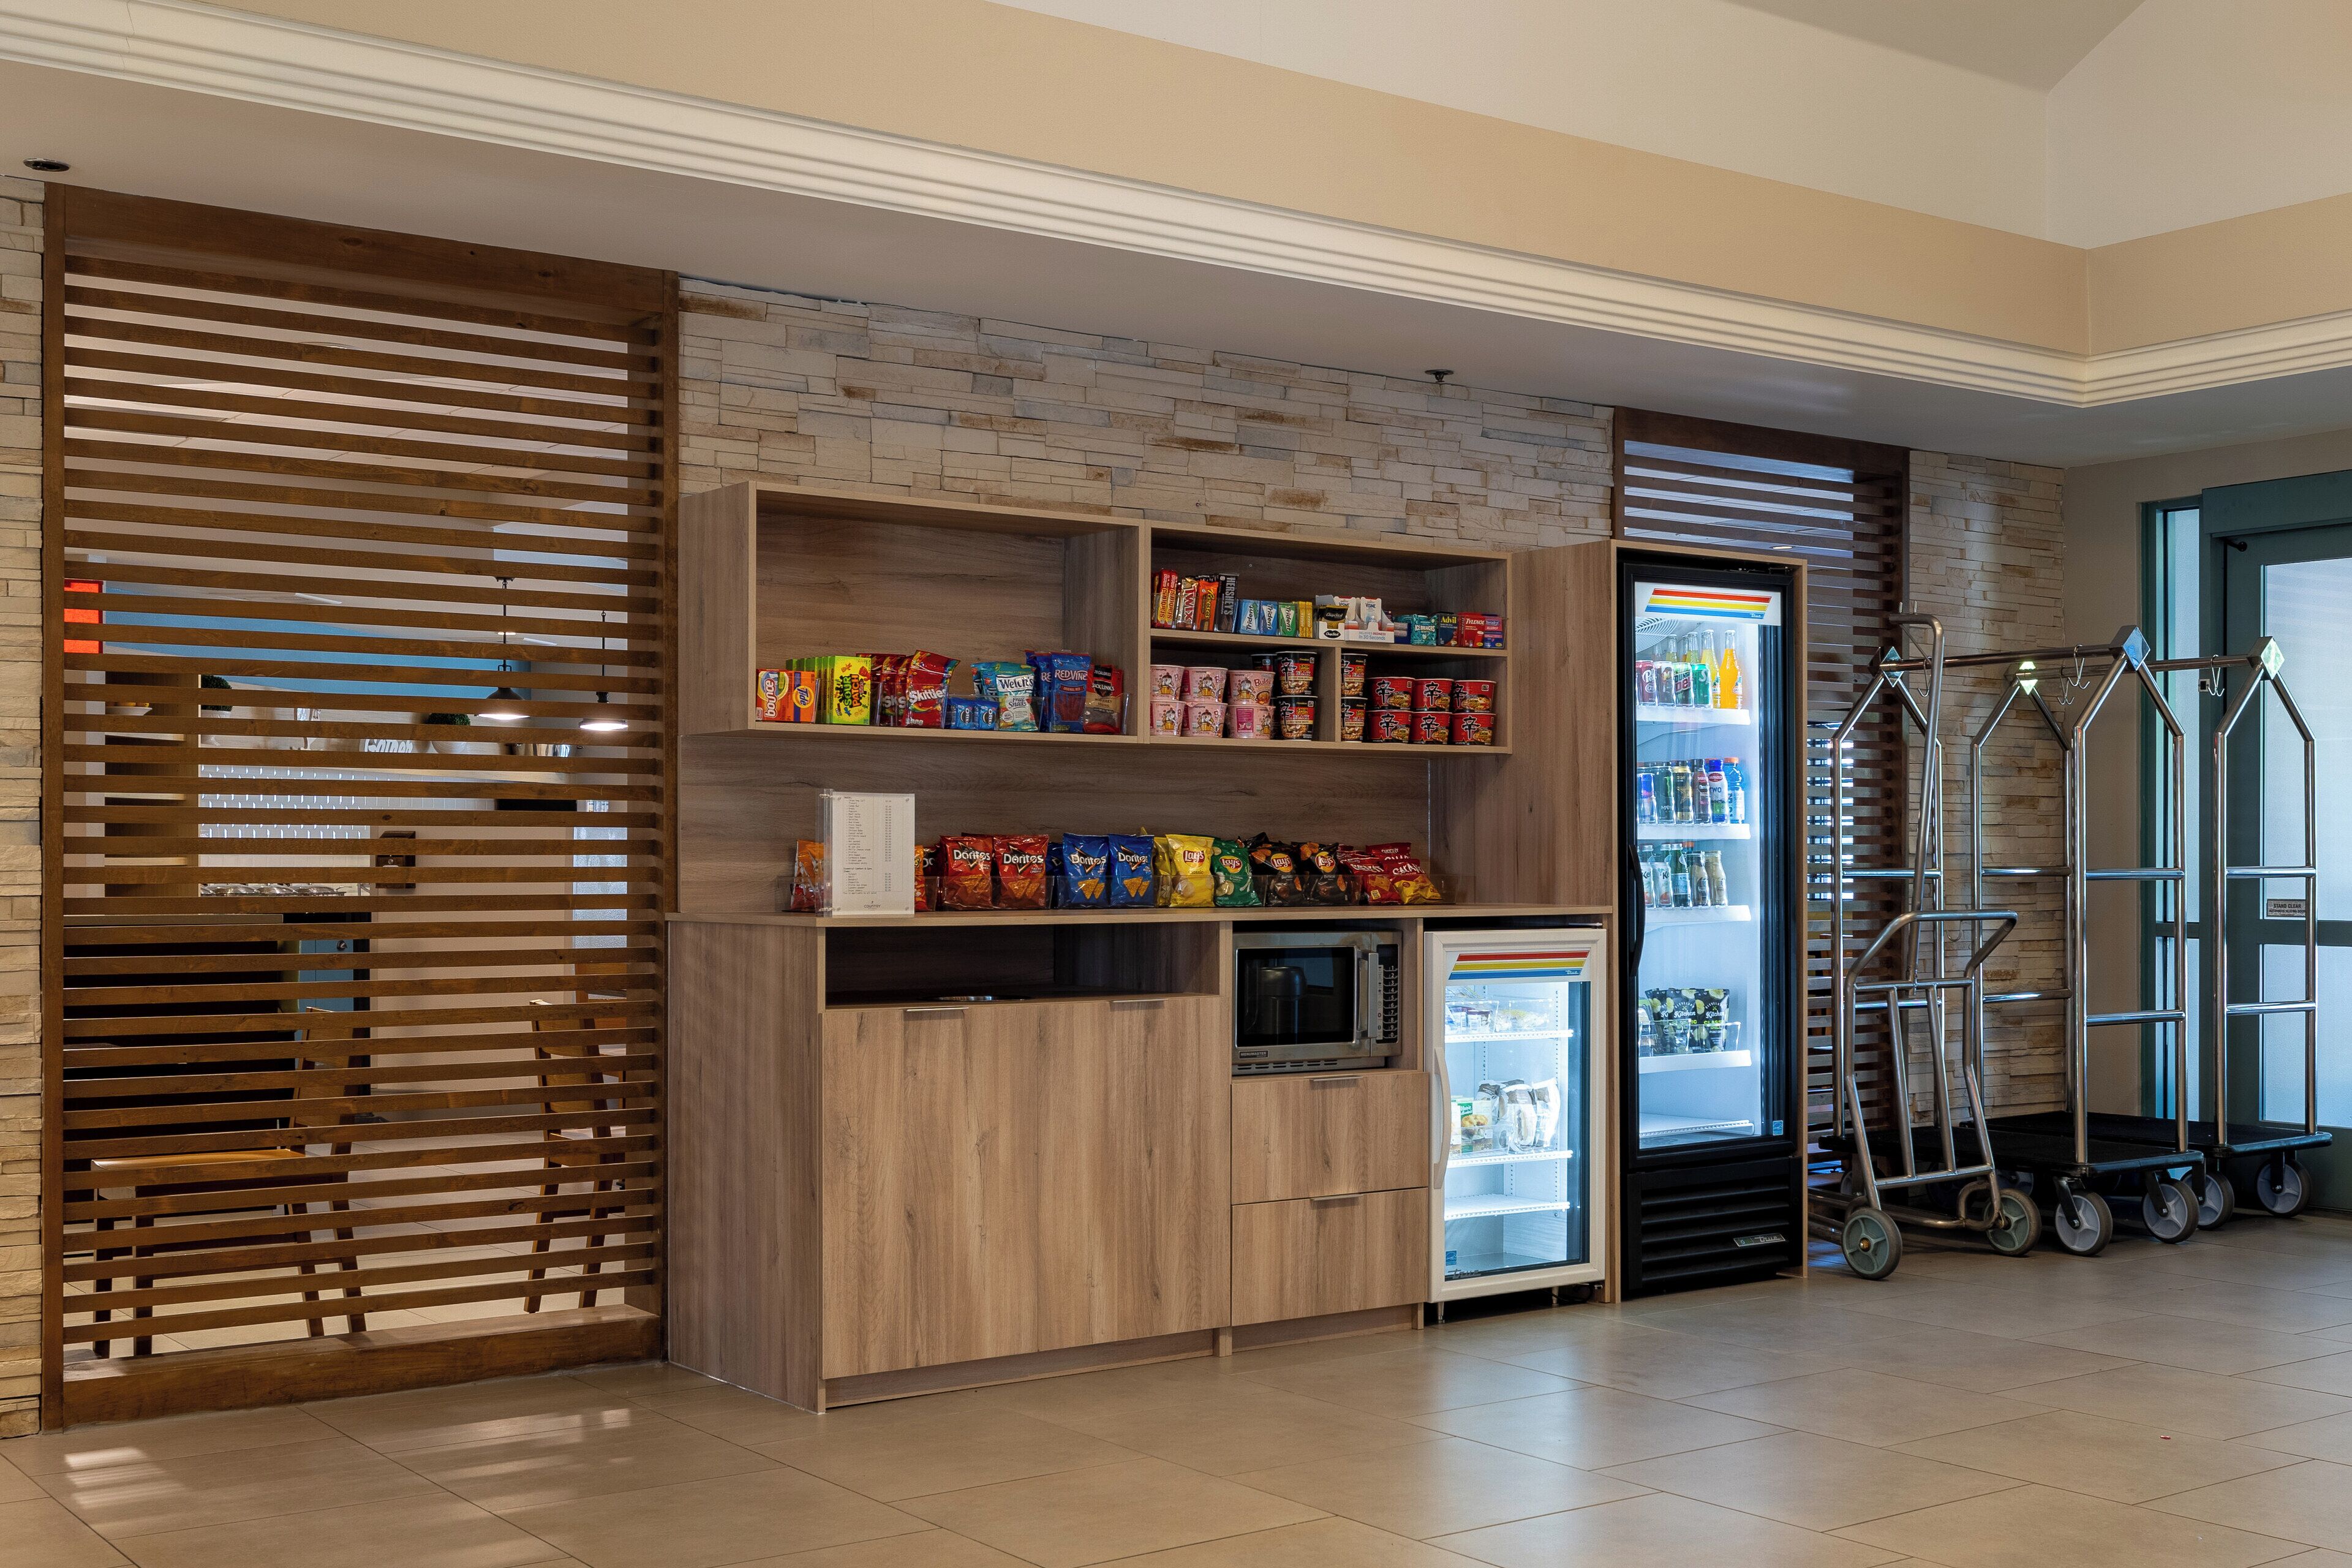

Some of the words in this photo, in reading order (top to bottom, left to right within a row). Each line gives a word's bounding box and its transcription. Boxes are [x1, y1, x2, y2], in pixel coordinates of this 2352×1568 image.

[1185, 588, 1197, 624] TWIX
[1041, 672, 1051, 682] RE
[1071, 670, 1088, 680] VINE
[764, 680, 776, 718] bounce
[796, 688, 810, 706] Tide
[843, 676, 852, 706] SOUR
[851, 674, 861, 707] PATCH
[1376, 679, 1395, 704] 辛
[1423, 680, 1442, 706] 辛
[1379, 712, 1399, 737] 辛
[1420, 714, 1439, 739] 辛
[1461, 715, 1481, 740] 辛
[954, 850, 990, 861] Doritos
[1003, 853, 1044, 864] Doritos
[1071, 854, 1106, 865] Doritos
[1185, 850, 1204, 862] Lay's
[1222, 859, 1240, 868] Lay's
[1273, 858, 1290, 867] Lay's
